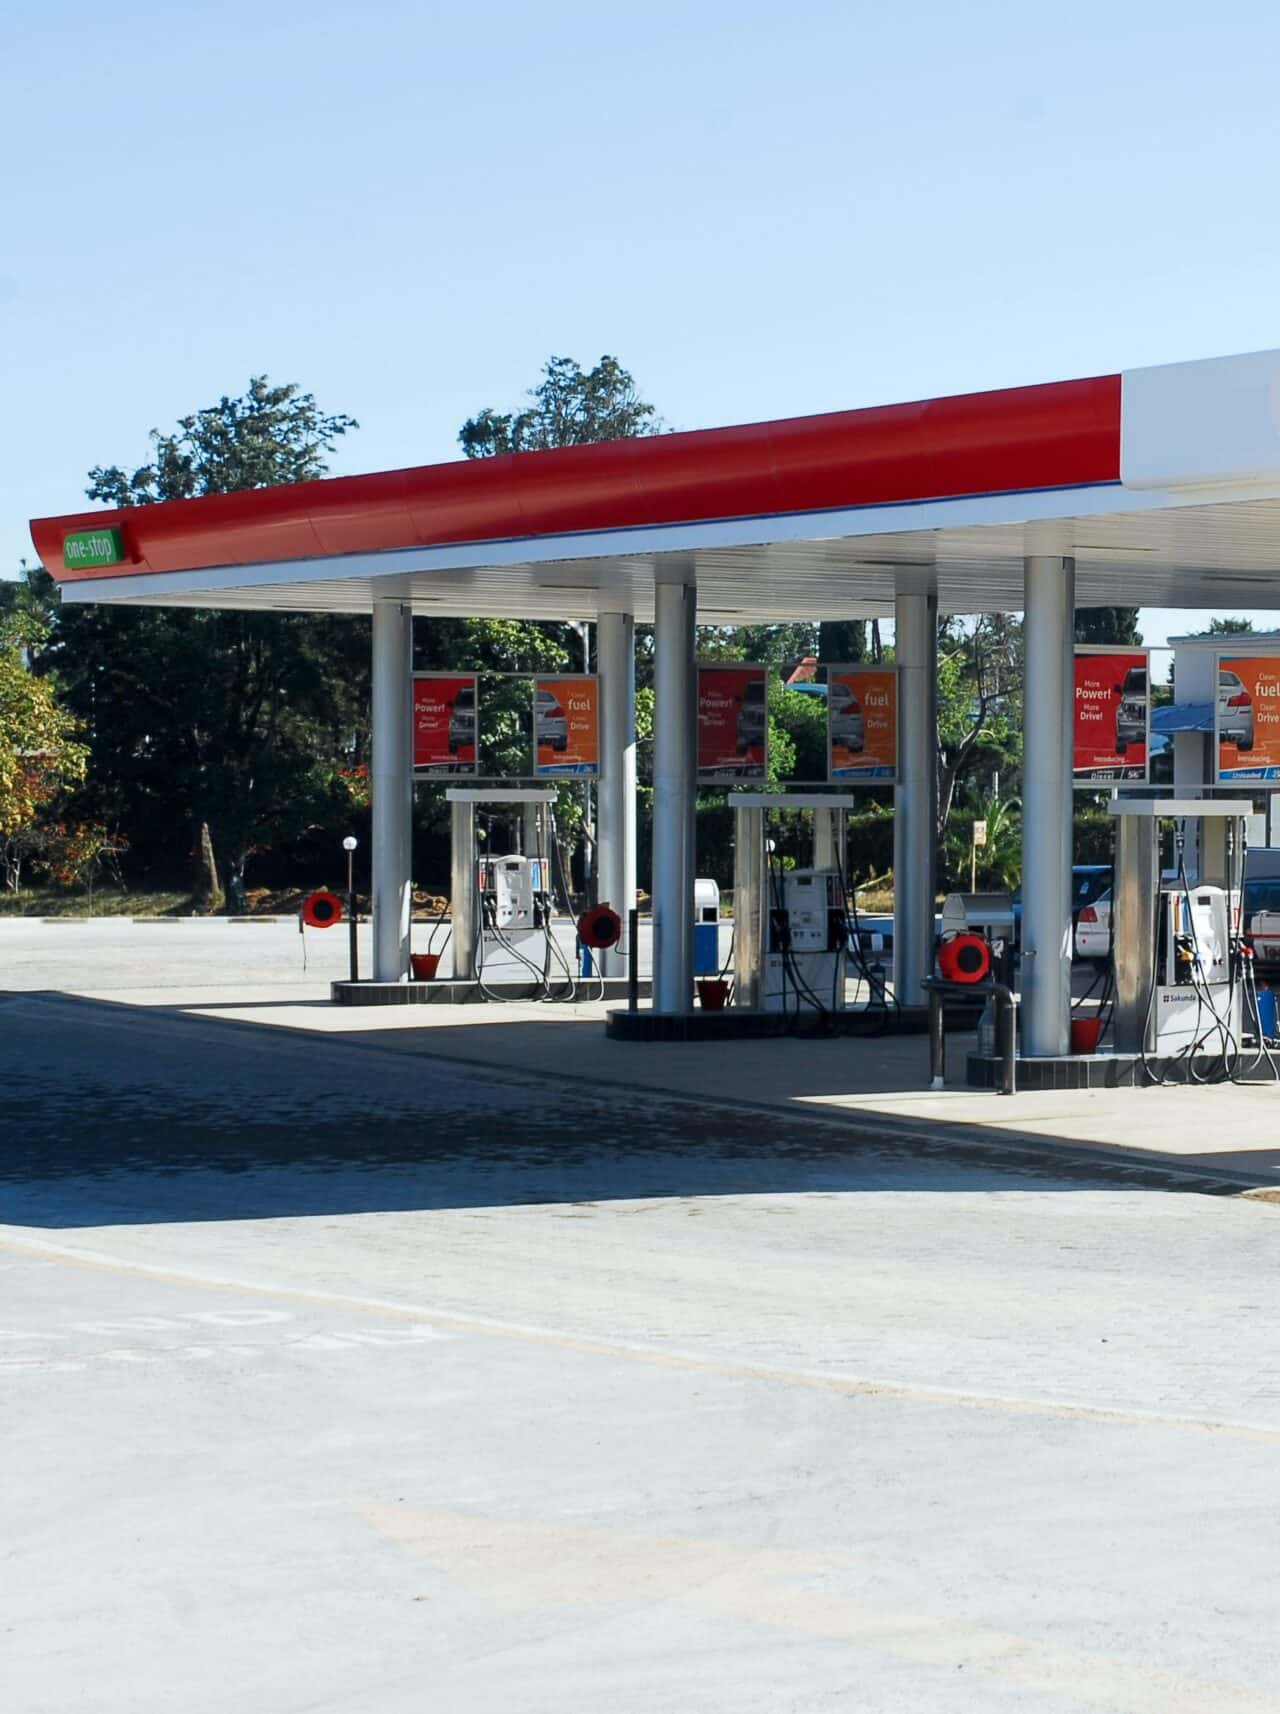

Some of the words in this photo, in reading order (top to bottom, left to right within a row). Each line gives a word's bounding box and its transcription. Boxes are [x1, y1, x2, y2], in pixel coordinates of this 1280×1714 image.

[66, 535, 112, 562] one-stop
[1075, 687, 1111, 700] Power!
[1255, 681, 1280, 697] fuel
[568, 698, 591, 711] fuel
[864, 691, 888, 706] fuel
[415, 703, 445, 713] Power!
[1080, 711, 1103, 721] Drive!
[1257, 712, 1280, 723] Drive
